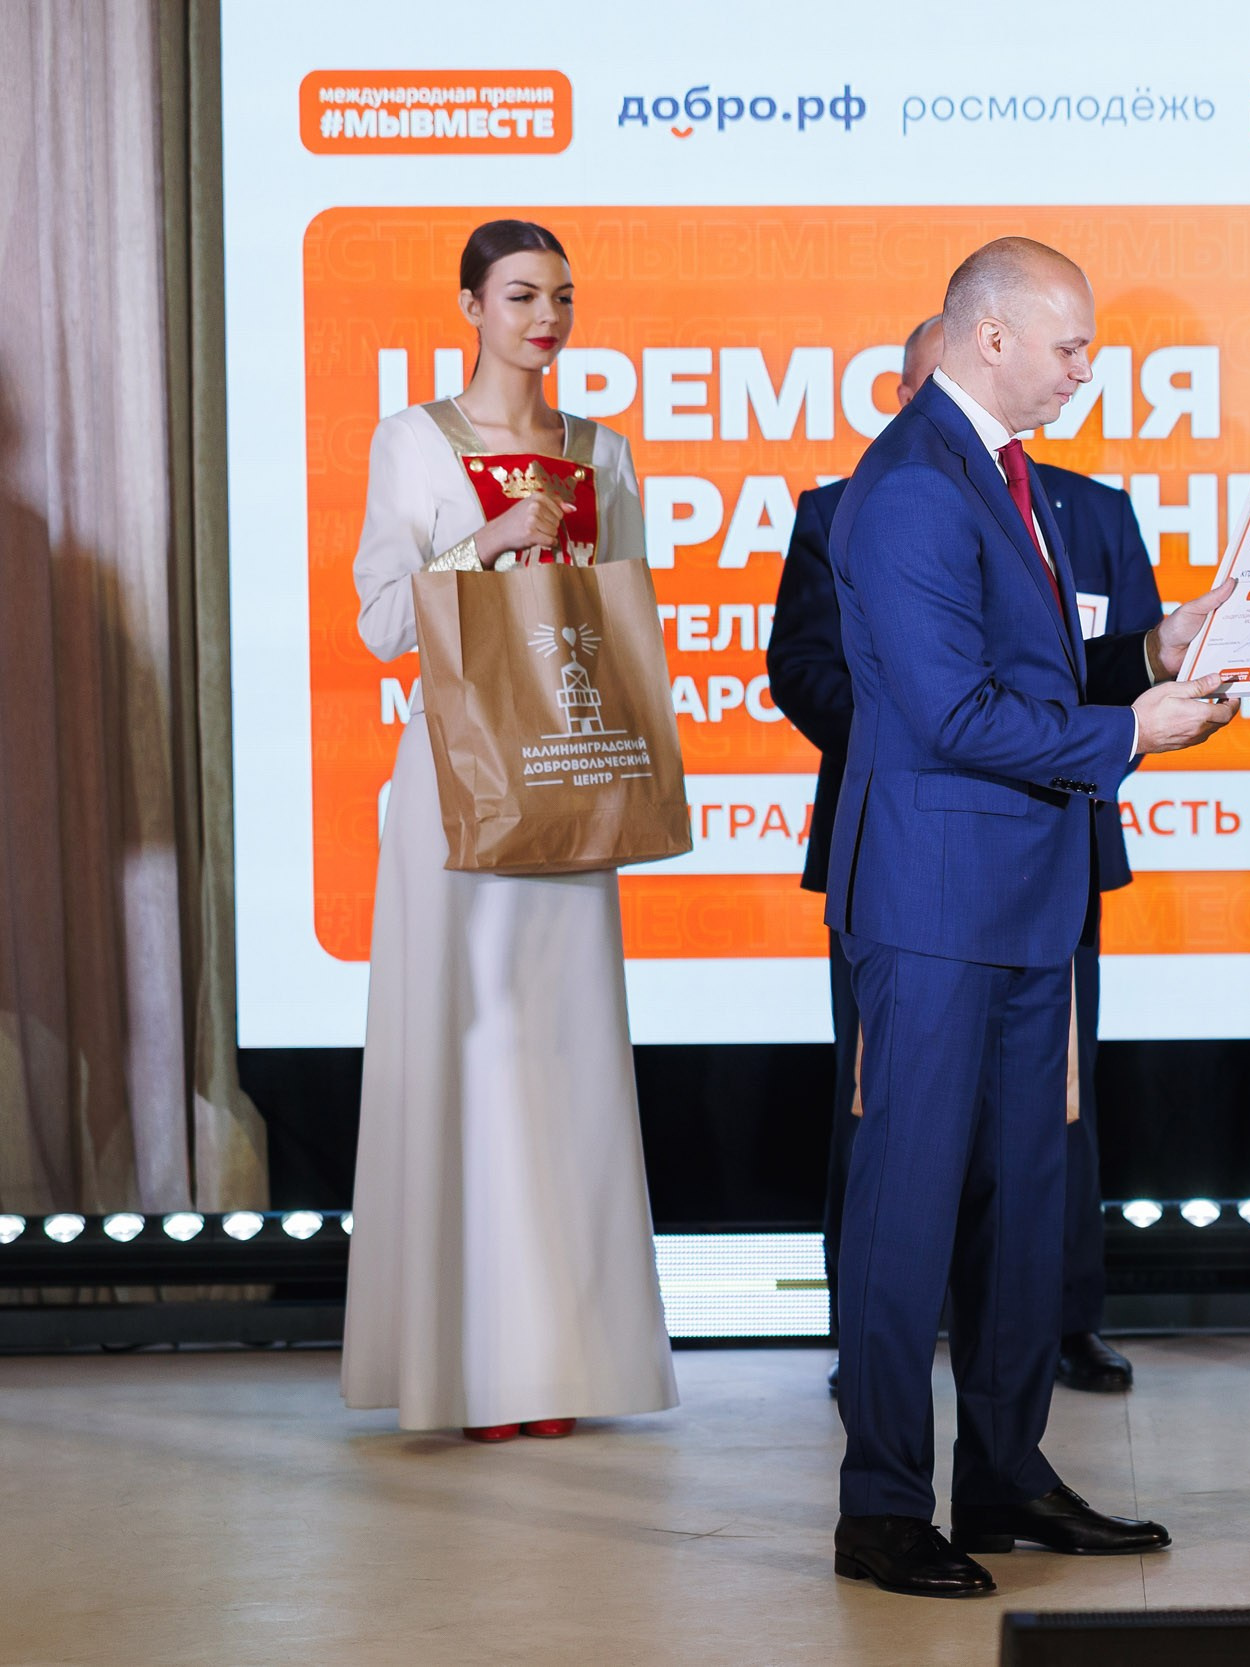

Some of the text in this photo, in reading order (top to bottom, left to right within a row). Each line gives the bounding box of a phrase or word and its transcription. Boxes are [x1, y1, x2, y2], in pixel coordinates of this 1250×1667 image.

[319, 87, 554, 108] международная премия
[618, 84, 866, 131] добро.рф
[902, 86, 1215, 136] росмолодёжь
[320, 108, 554, 138] #МЫВМЕСТЕ
[378, 345, 1220, 441] ЦРЕМОИЯ
[522, 737, 647, 758] КАЛИНИНГРАДСКИЙ
[524, 752, 650, 776] ДОБРОВОЛЬЧЕСКИЙ
[573, 772, 613, 786] ЦЕНТР
